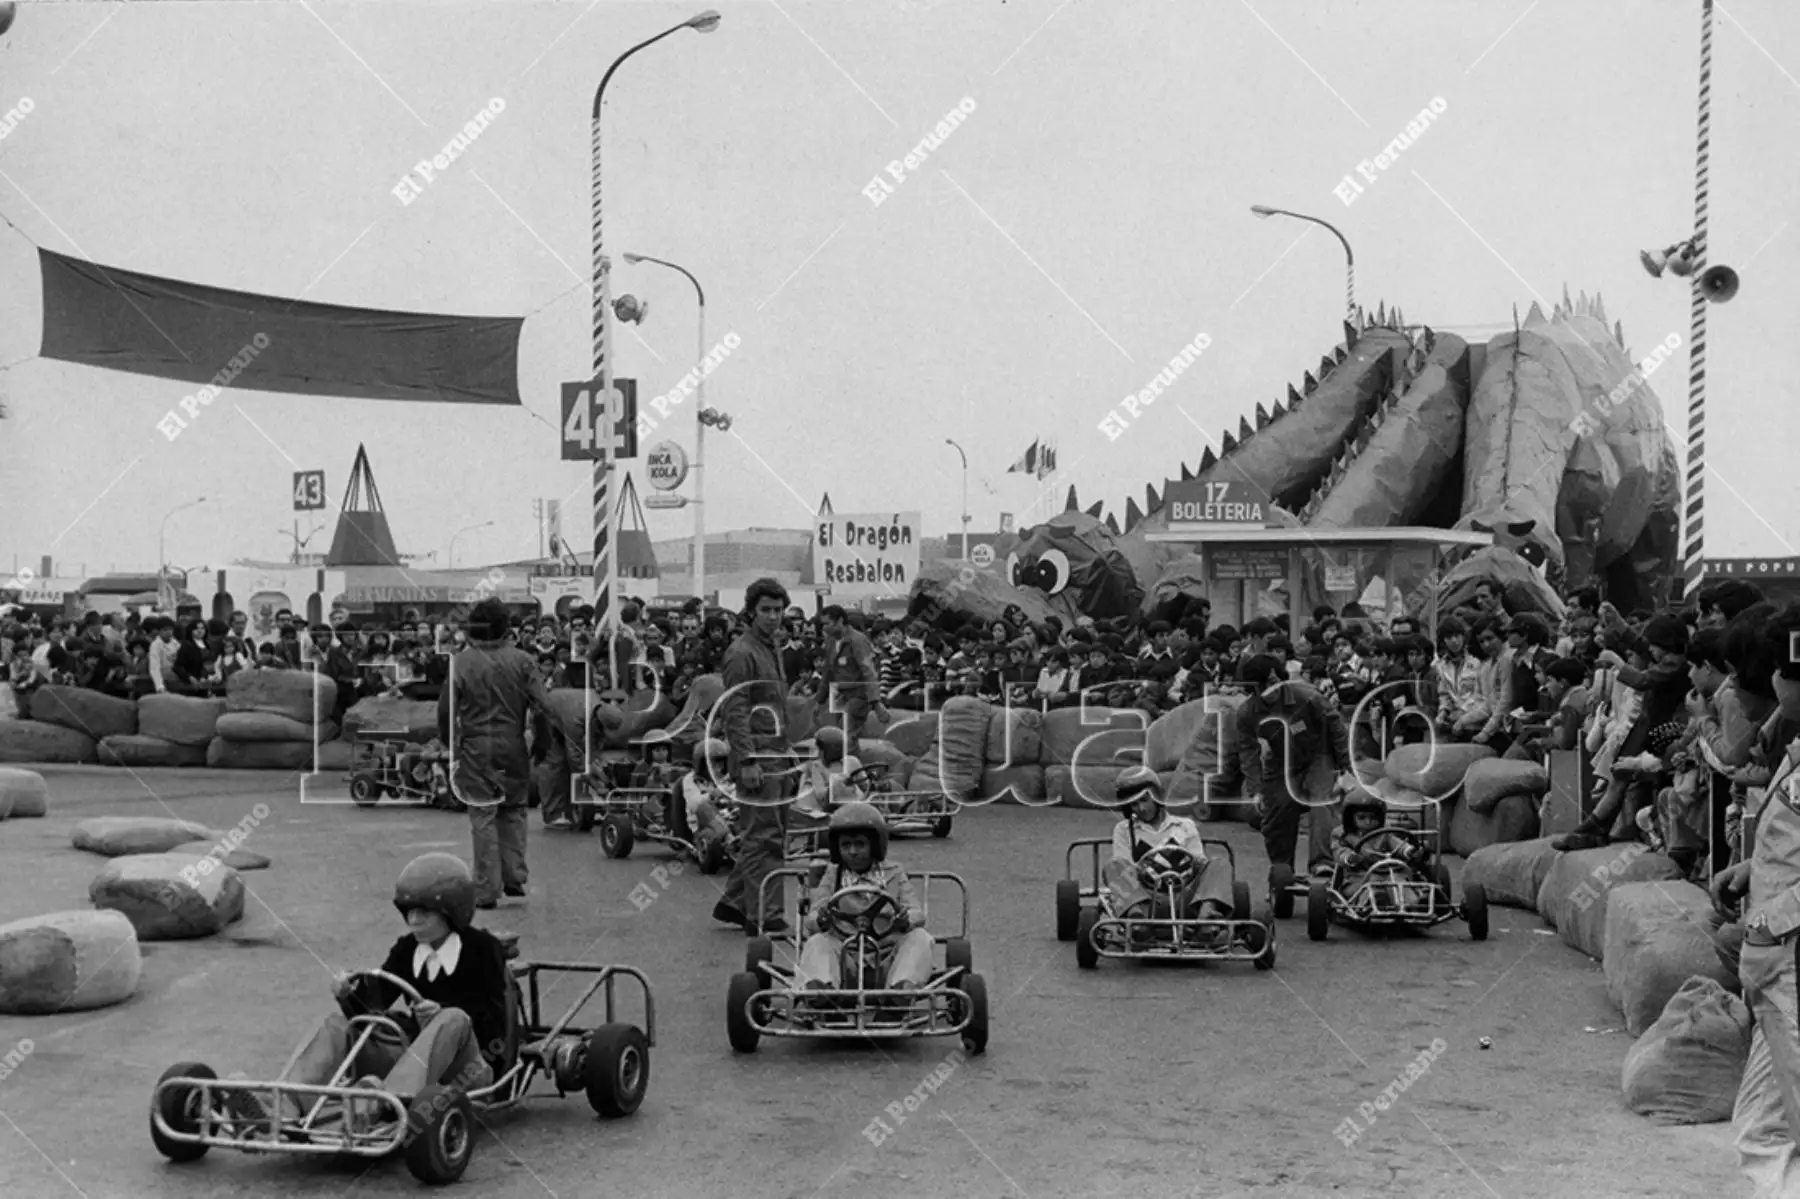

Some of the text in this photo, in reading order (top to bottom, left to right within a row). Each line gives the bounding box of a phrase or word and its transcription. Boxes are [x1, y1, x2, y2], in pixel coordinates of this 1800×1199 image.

[565, 387, 625, 450] 42
[648, 453, 673, 466] INCA
[651, 465, 678, 479] KOLA
[295, 474, 323, 506] 43
[1205, 481, 1230, 503] 17
[1172, 501, 1263, 521] BOLETERIA
[818, 513, 912, 551] El Dragón
